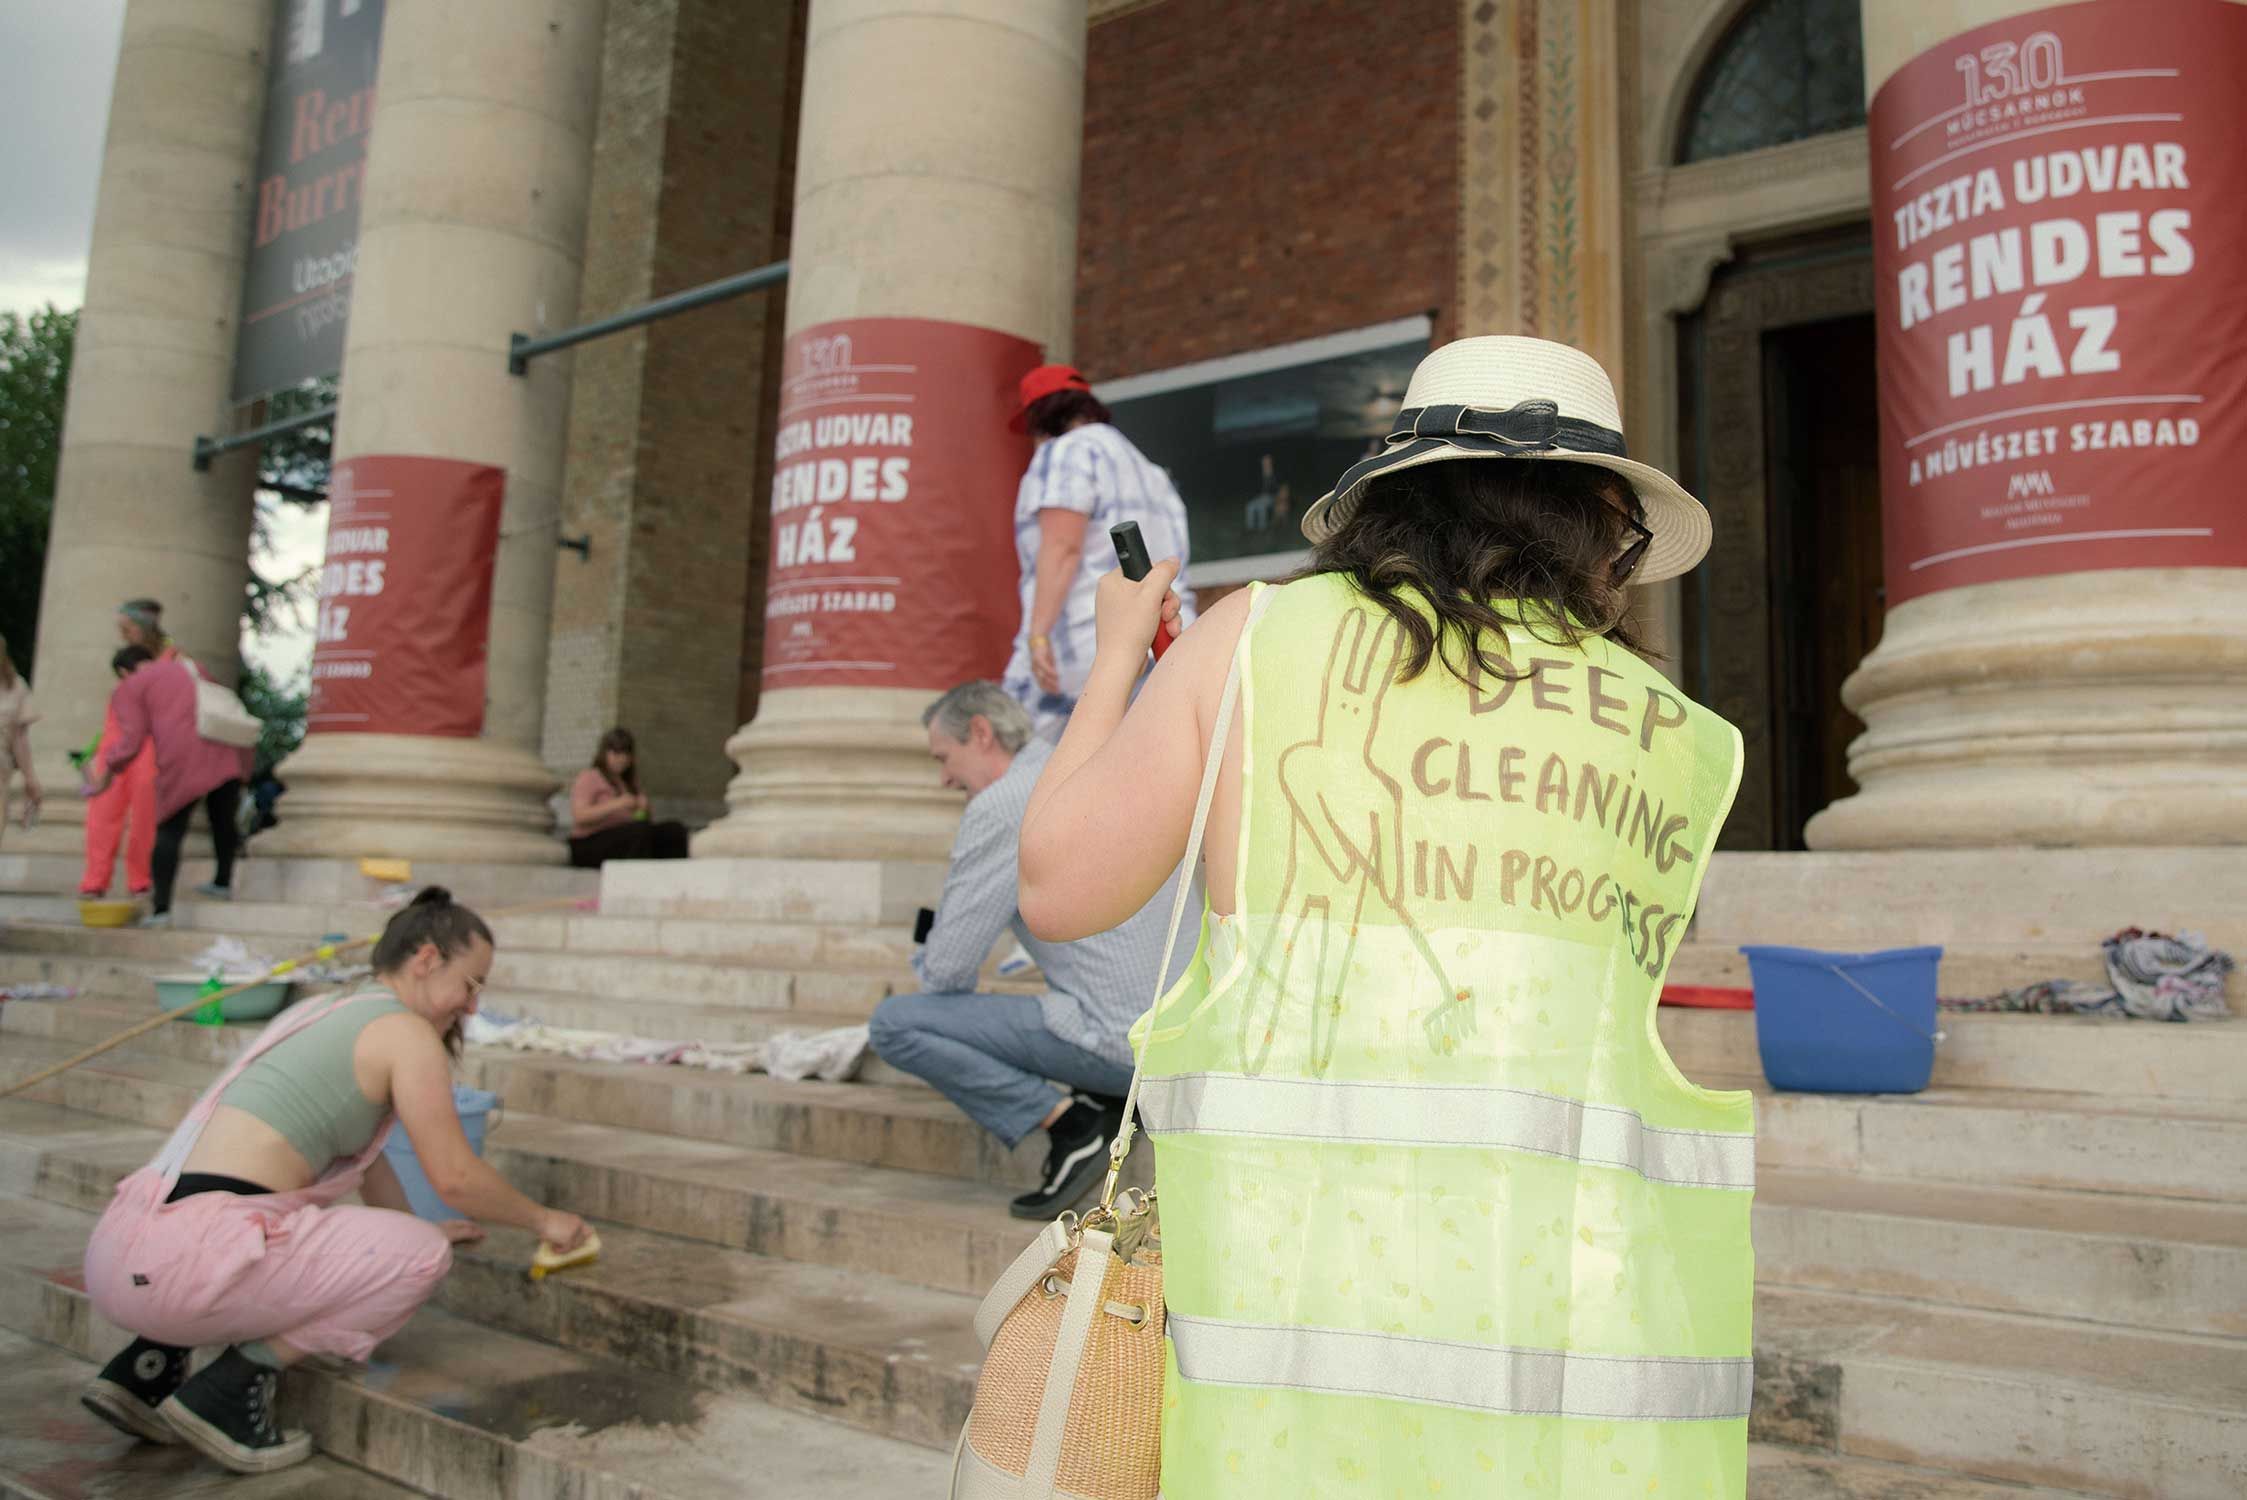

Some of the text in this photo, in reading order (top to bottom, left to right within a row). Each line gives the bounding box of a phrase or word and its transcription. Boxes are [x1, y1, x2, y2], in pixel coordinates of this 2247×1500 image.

[1955, 31, 2064, 107] 130
[1893, 143, 2190, 250] TISZTA UDVAR
[1898, 209, 2195, 331] RENDES
[1947, 293, 2121, 398] HÁZ
[815, 412, 913, 448] UDVAR
[1926, 426, 2059, 480] MŰVÉSZET
[2070, 418, 2200, 452] SZABAD
[777, 506, 858, 568] HÁZ
[1468, 650, 1688, 753] DEEP
[1414, 840, 1477, 901] IN
